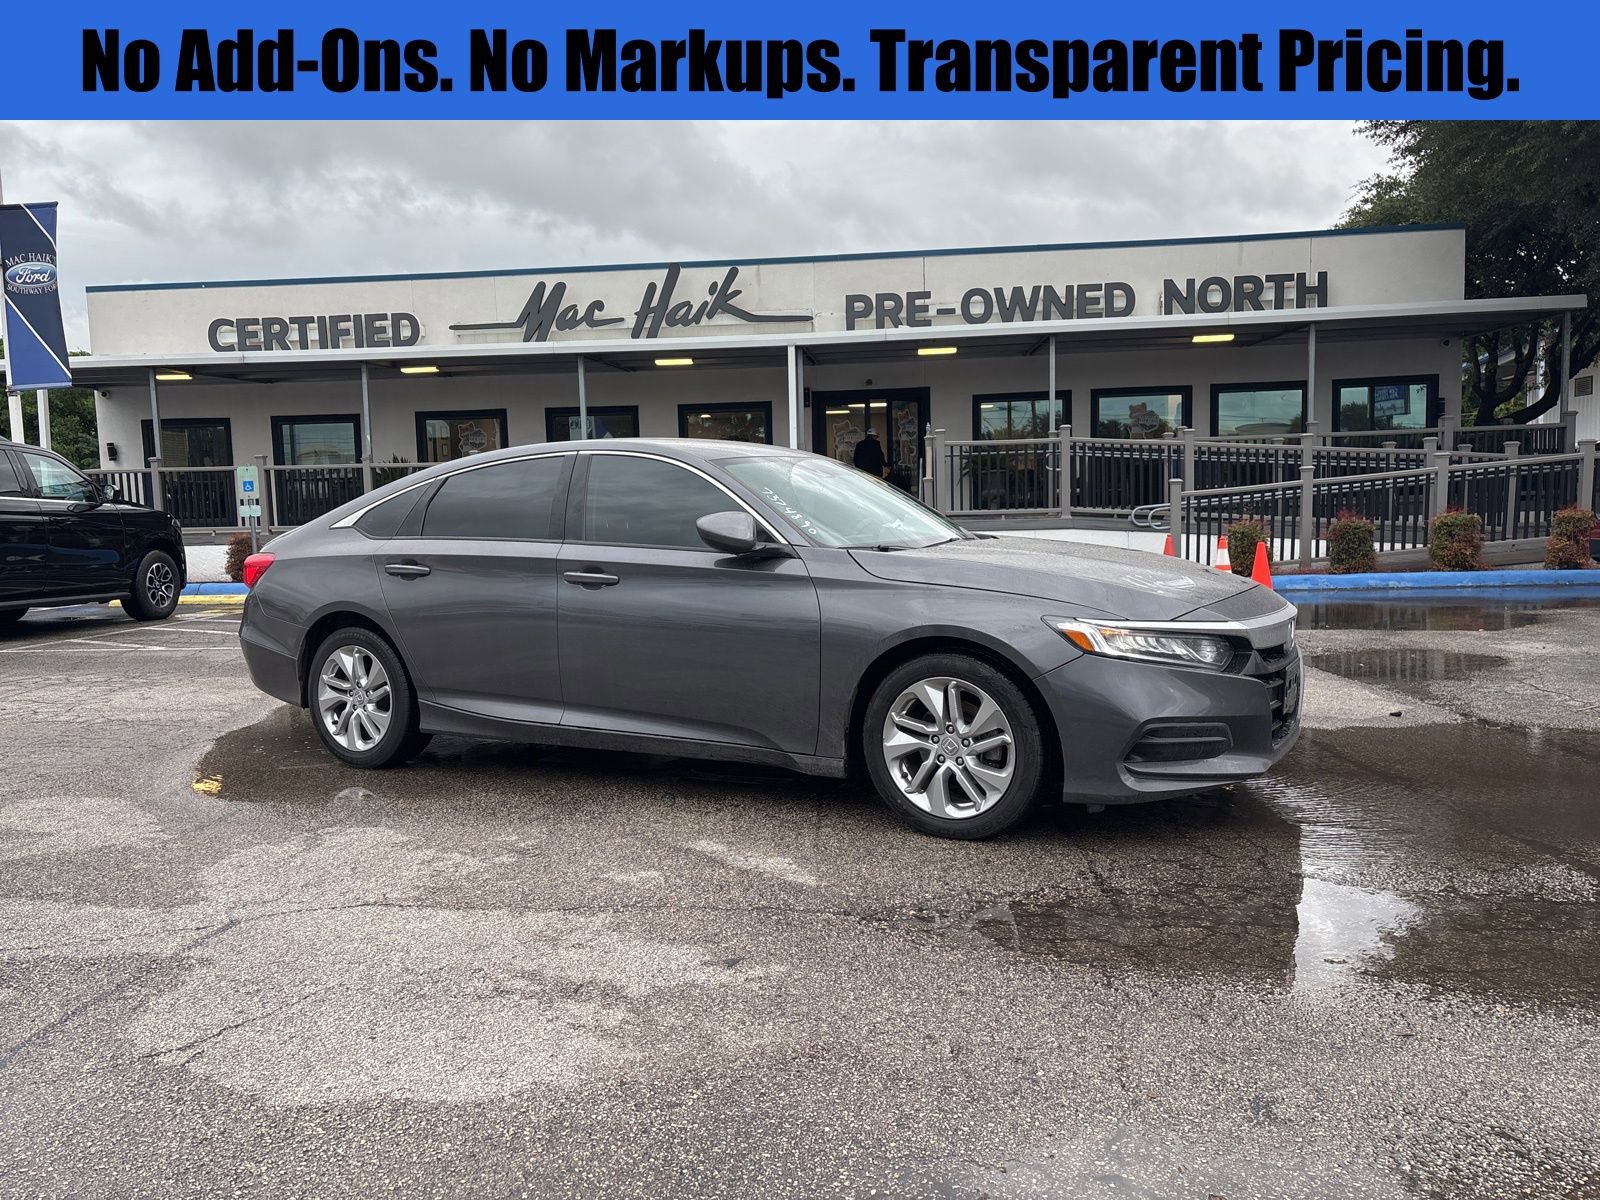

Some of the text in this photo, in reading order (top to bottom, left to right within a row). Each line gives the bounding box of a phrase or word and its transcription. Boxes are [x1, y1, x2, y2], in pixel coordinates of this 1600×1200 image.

[5, 253, 26, 268] MAC
[16, 265, 51, 283] Ford
[6, 283, 43, 295] SOUTHWAY
[449, 262, 814, 342] Mac Haik
[845, 271, 1329, 331] PRE-OWNED NORTH
[207, 312, 420, 352] CERTIFIED
